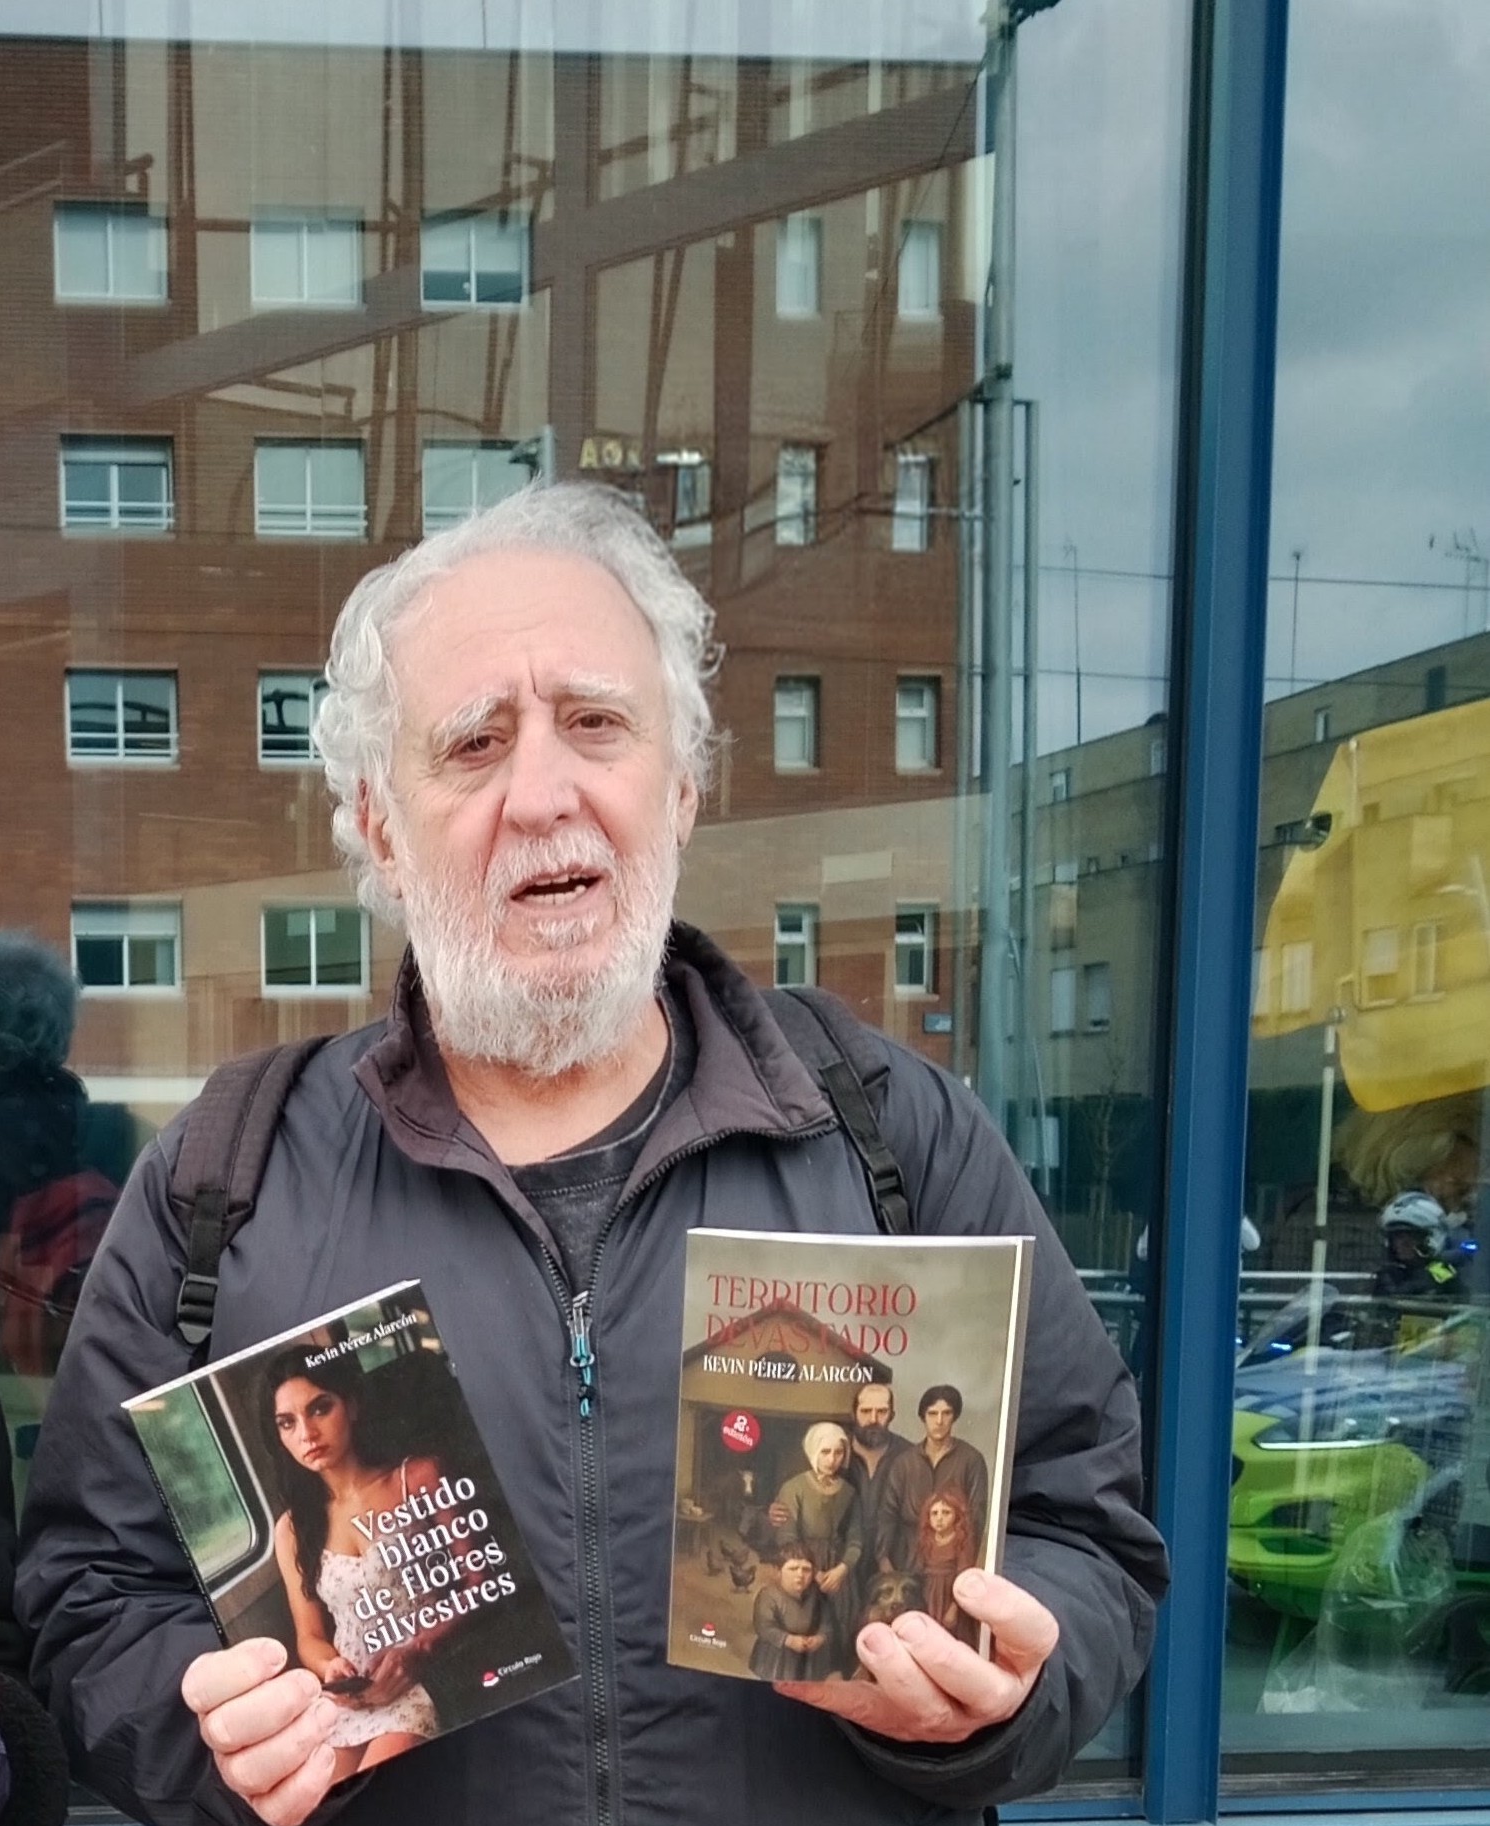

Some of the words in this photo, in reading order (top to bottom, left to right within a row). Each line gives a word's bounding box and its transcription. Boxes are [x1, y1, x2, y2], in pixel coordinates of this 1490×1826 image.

[707, 1274, 917, 1317] TERRITORIO
[304, 1348, 339, 1368] Kevin
[339, 1333, 372, 1354] Pérez
[373, 1314, 417, 1340] Alarcón
[706, 1314, 908, 1356] DEVASTADO
[703, 1354, 745, 1374] KEVIN
[749, 1357, 796, 1380] PÉREZ
[799, 1362, 873, 1383] ALARCÓN
[351, 1476, 475, 1541] Vestido
[377, 1508, 488, 1571] blanco
[355, 1586, 394, 1620] de
[402, 1541, 503, 1600] flores
[363, 1572, 516, 1653] silvestres
